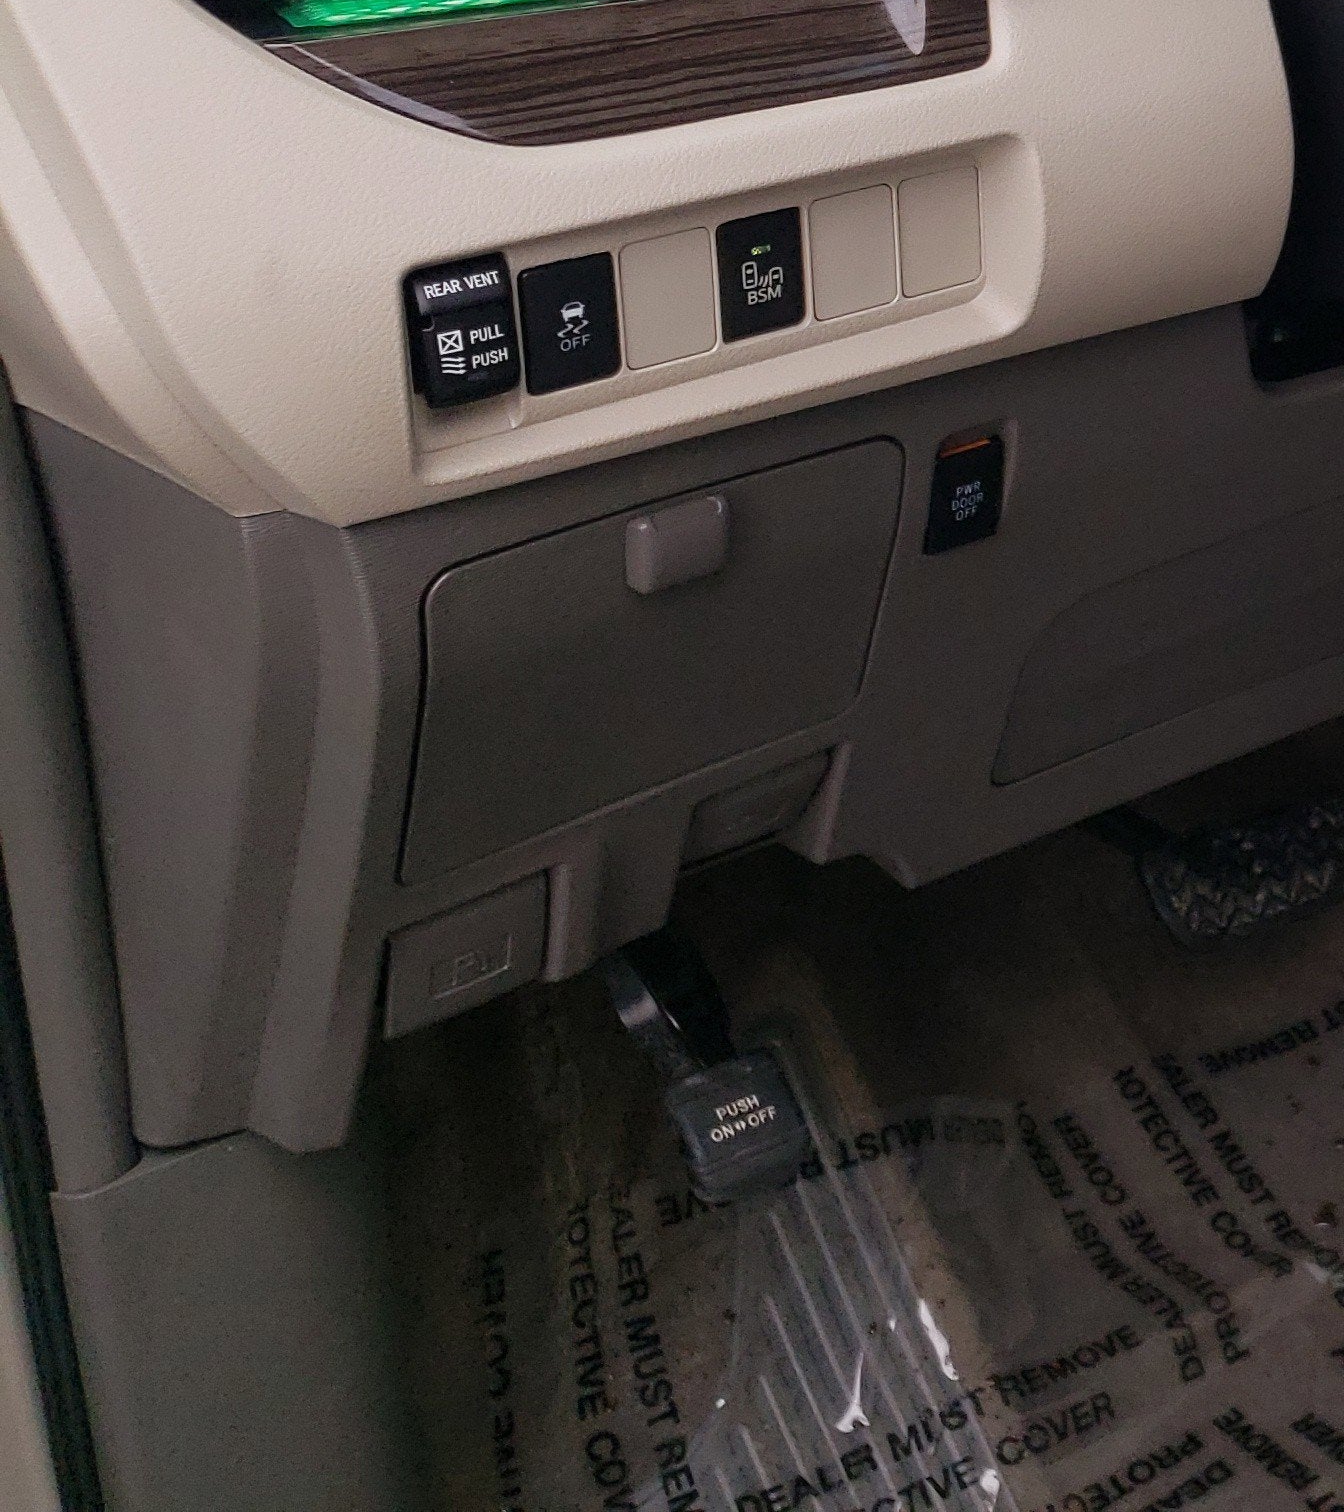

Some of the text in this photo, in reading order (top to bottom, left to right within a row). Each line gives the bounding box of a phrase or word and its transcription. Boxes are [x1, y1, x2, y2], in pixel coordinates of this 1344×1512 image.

[423, 269, 500, 302] REAR VENT
[746, 284, 783, 308] BSM
[469, 324, 505, 345] PULL
[559, 331, 592, 353] OFF
[471, 346, 509, 370] PUSH
[955, 479, 982, 498] PWR
[951, 491, 985, 511] DOOR
[954, 503, 979, 523] OFF
[716, 1093, 760, 1121] PUSH
[710, 1105, 777, 1143] ON OFF
[624, 1315, 682, 1426] MUST
[987, 1324, 1141, 1406] REMOVE
[995, 1391, 1116, 1466] COVER
